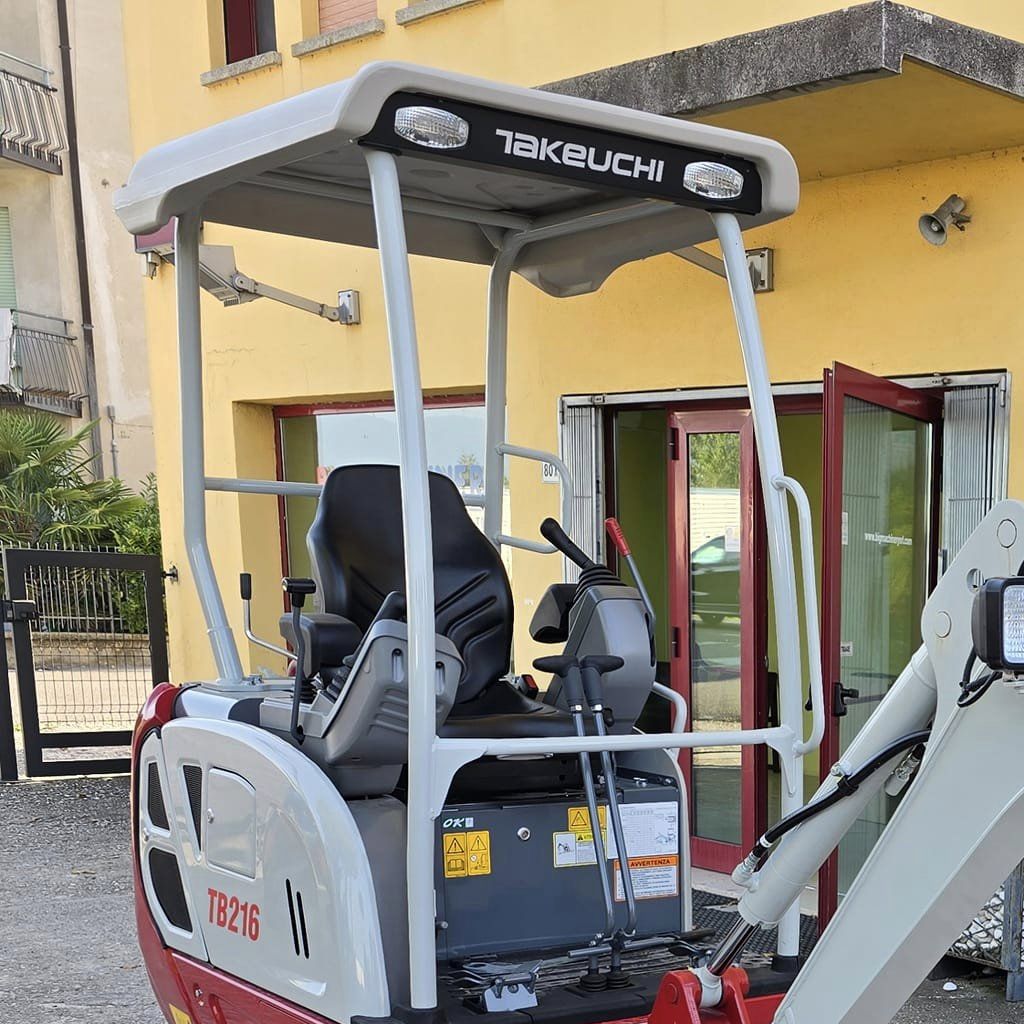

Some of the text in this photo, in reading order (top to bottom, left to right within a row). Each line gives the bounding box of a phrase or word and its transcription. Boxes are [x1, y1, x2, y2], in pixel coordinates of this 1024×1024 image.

[443, 818, 465, 828] OK
[630, 859, 671, 867] AVVERTENZA
[208, 888, 260, 941] TB216
